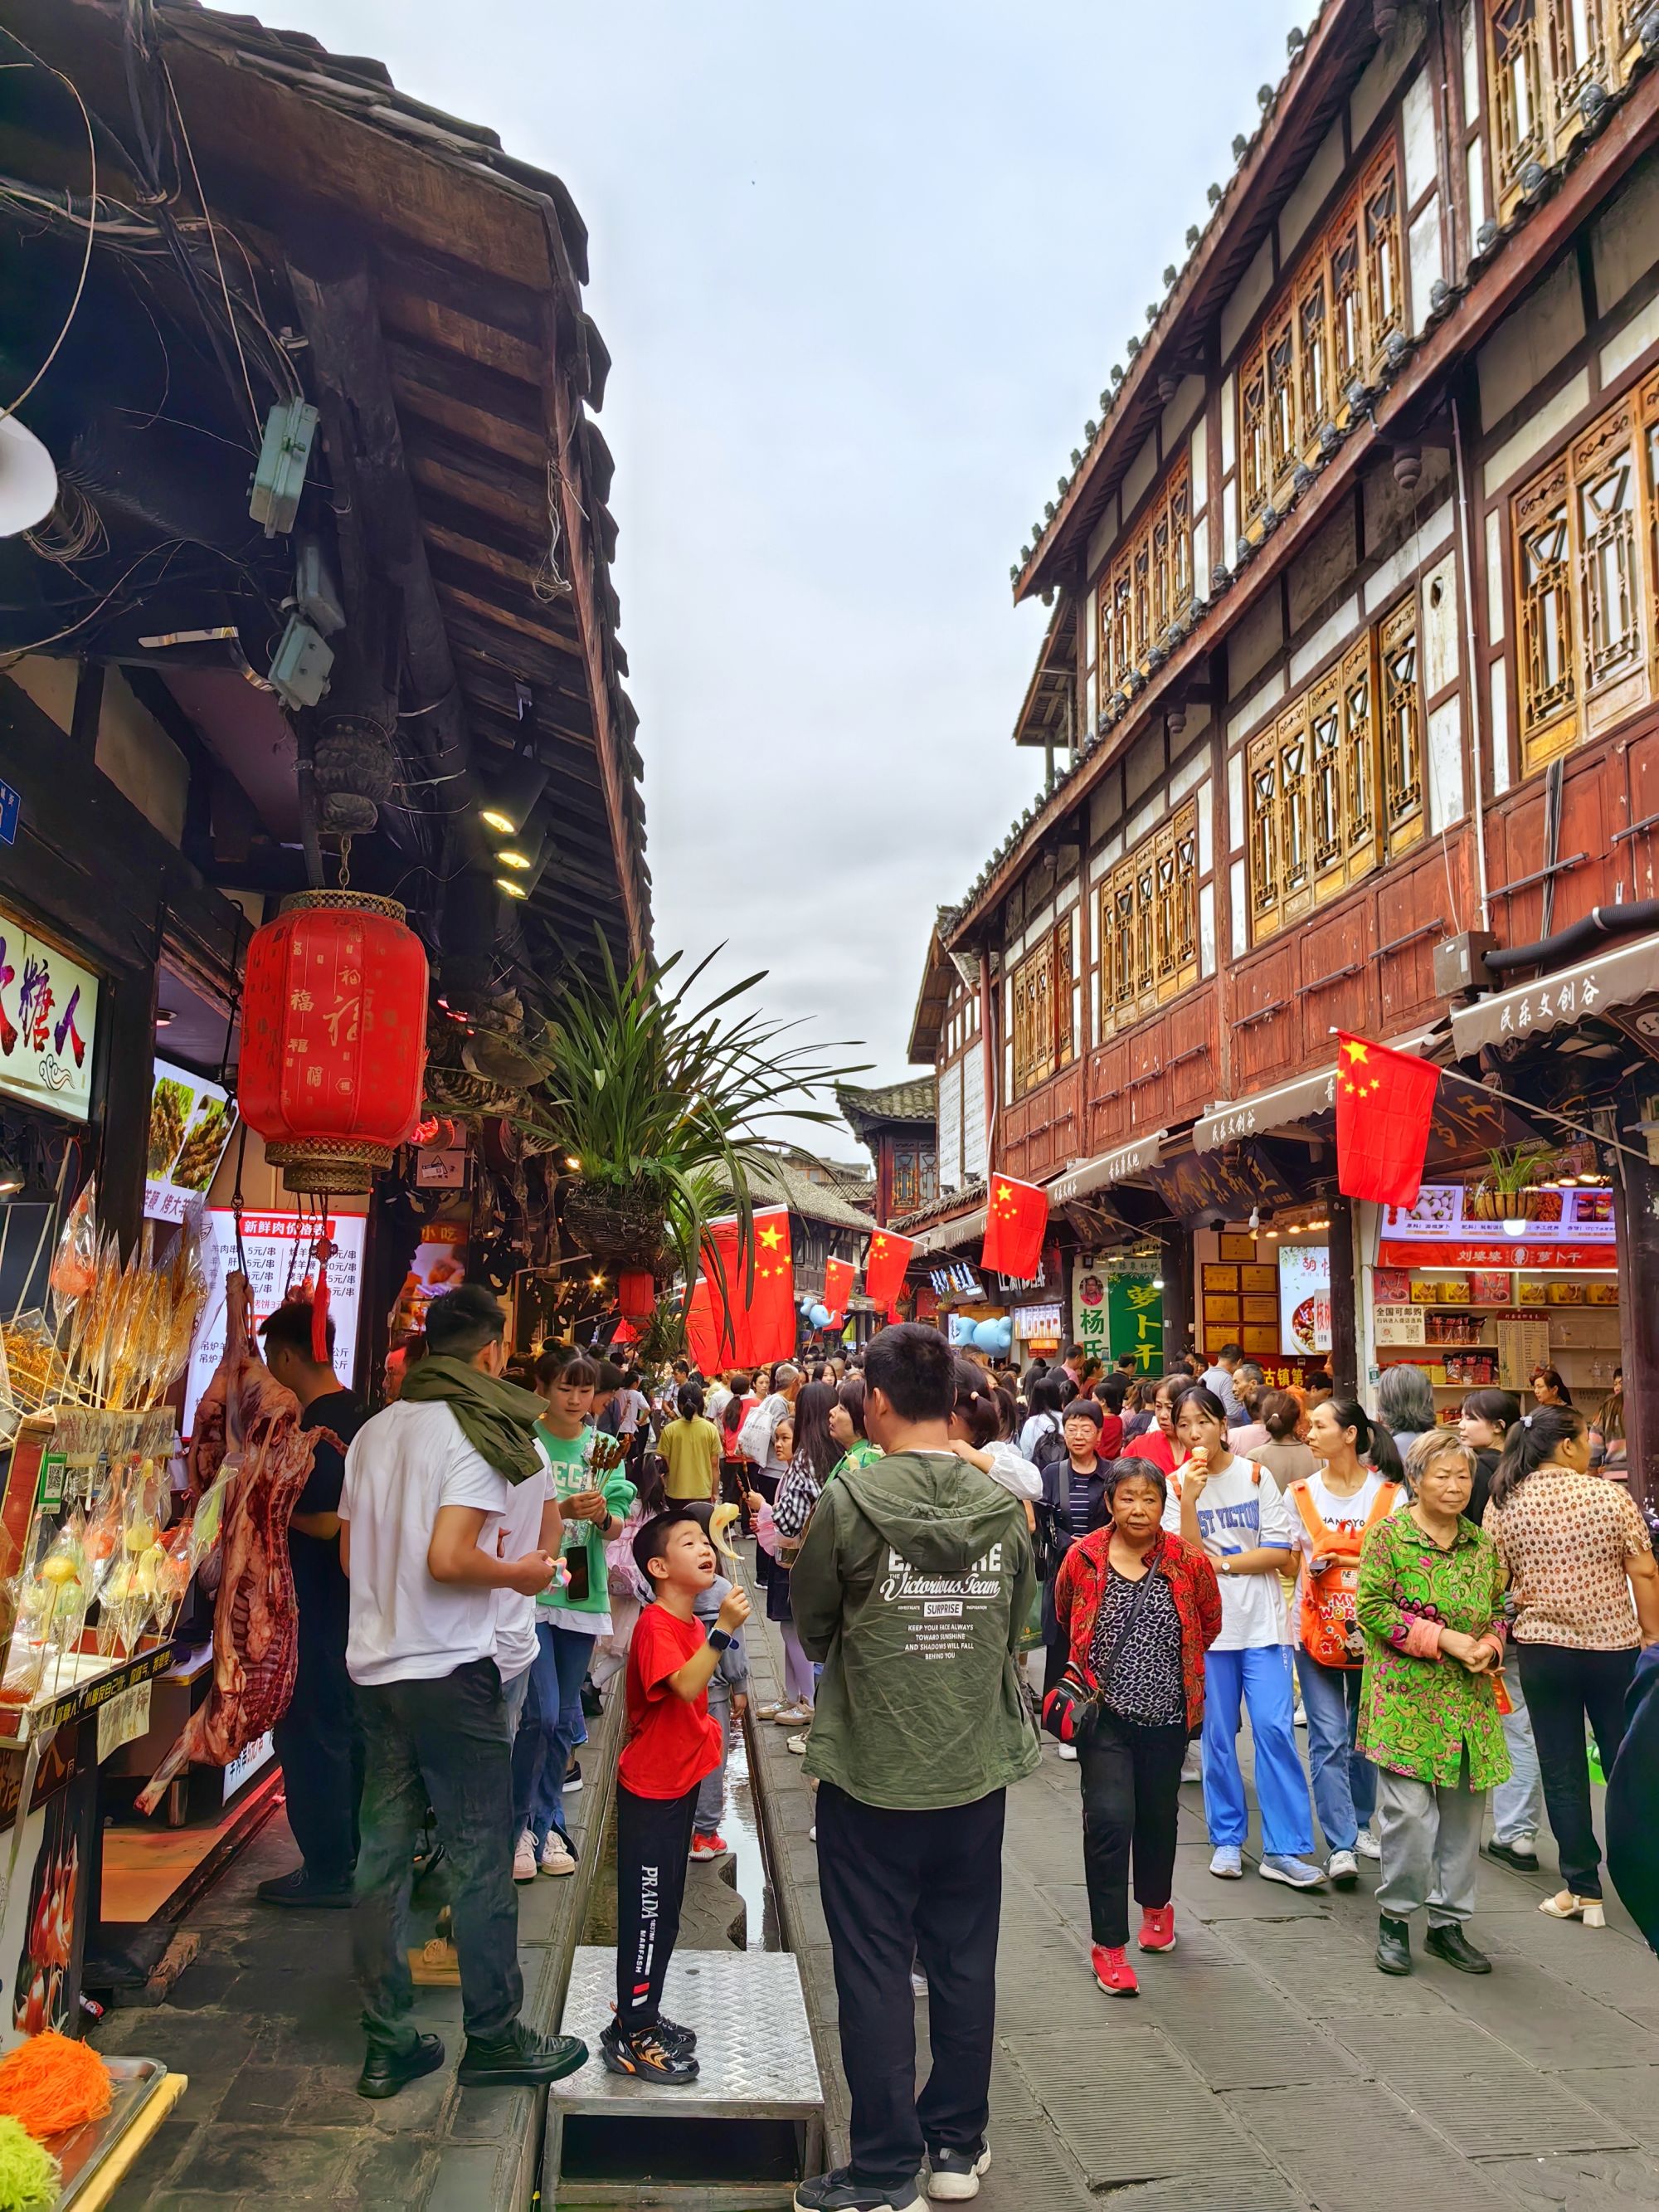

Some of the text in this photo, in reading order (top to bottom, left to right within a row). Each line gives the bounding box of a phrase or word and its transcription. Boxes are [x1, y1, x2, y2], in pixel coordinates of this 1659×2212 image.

[1536, 1251, 1583, 1264] 萝卜干
[328, 1274, 356, 1284] 5元/串
[1263, 1367, 1308, 1387] 古镇第
[1198, 1509, 1216, 1537] ST
[879, 1571, 961, 1601] Victorious
[960, 1573, 1001, 1596] Team
[927, 1603, 961, 1615] SURPRISE
[1319, 1606, 1355, 1620] WOR
[951, 1623, 975, 1631] ALWAYS
[940, 1632, 966, 1640] SUNSHINE
[944, 1651, 956, 1659] YOU
[641, 1864, 659, 1920] PRADA
[635, 1929, 647, 1974] MARFASH
